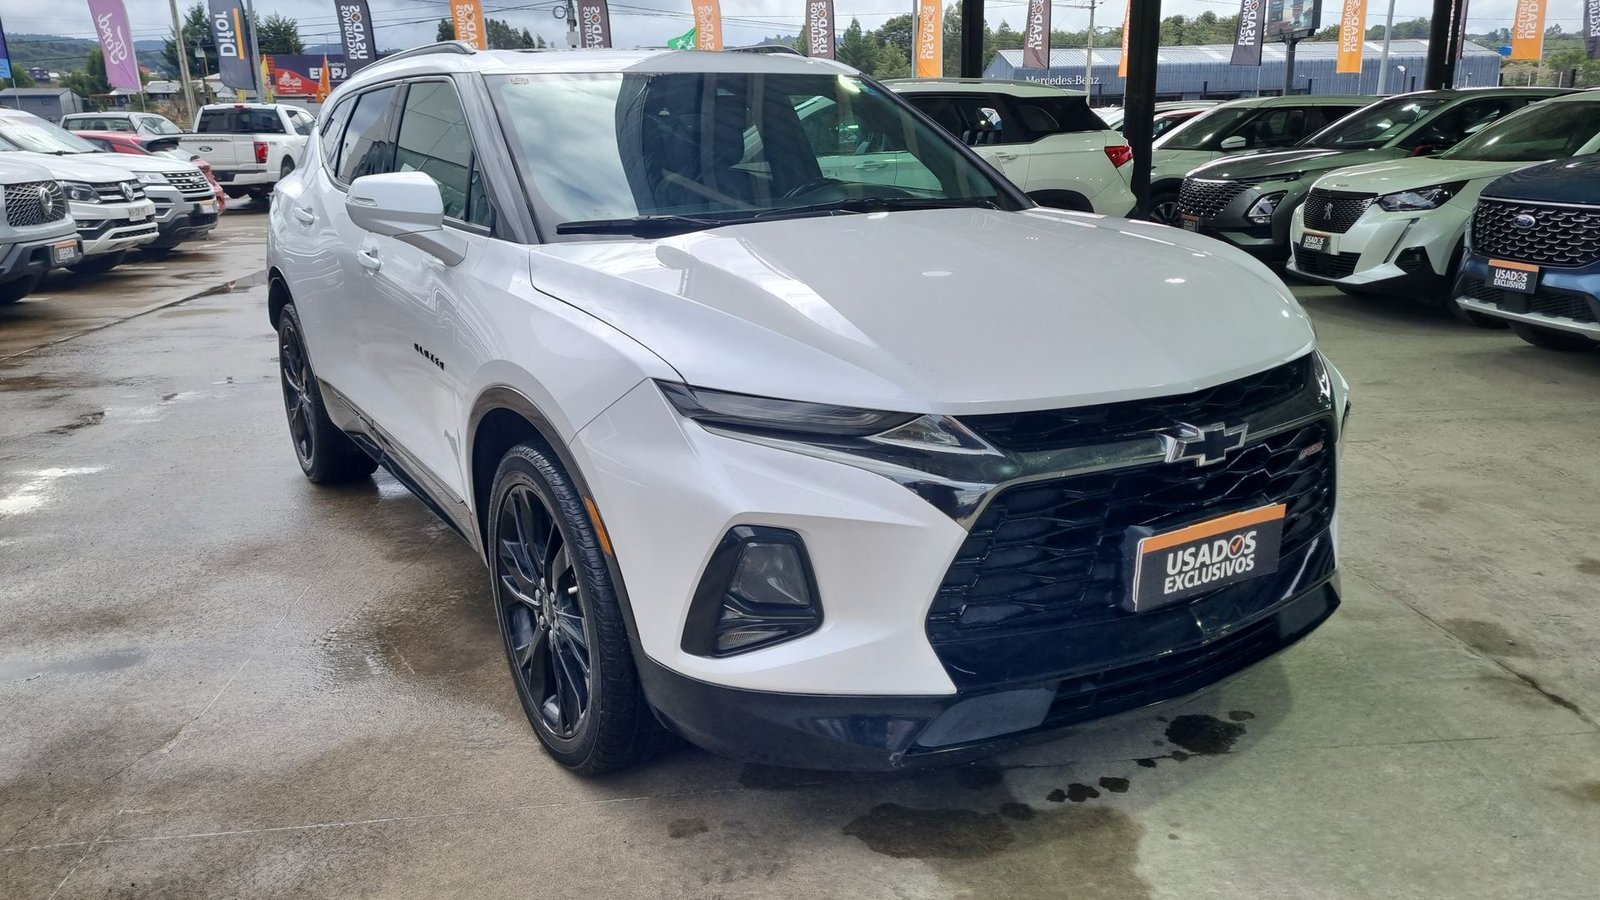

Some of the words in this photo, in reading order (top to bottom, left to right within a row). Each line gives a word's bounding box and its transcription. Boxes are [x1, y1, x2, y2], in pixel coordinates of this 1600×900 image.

[1493, 278, 1527, 290] EXCLUSIVOS
[1495, 268, 1528, 282] USADOS
[1166, 530, 1257, 575] USADOS
[1163, 553, 1255, 595] EXCLUSIVOS
